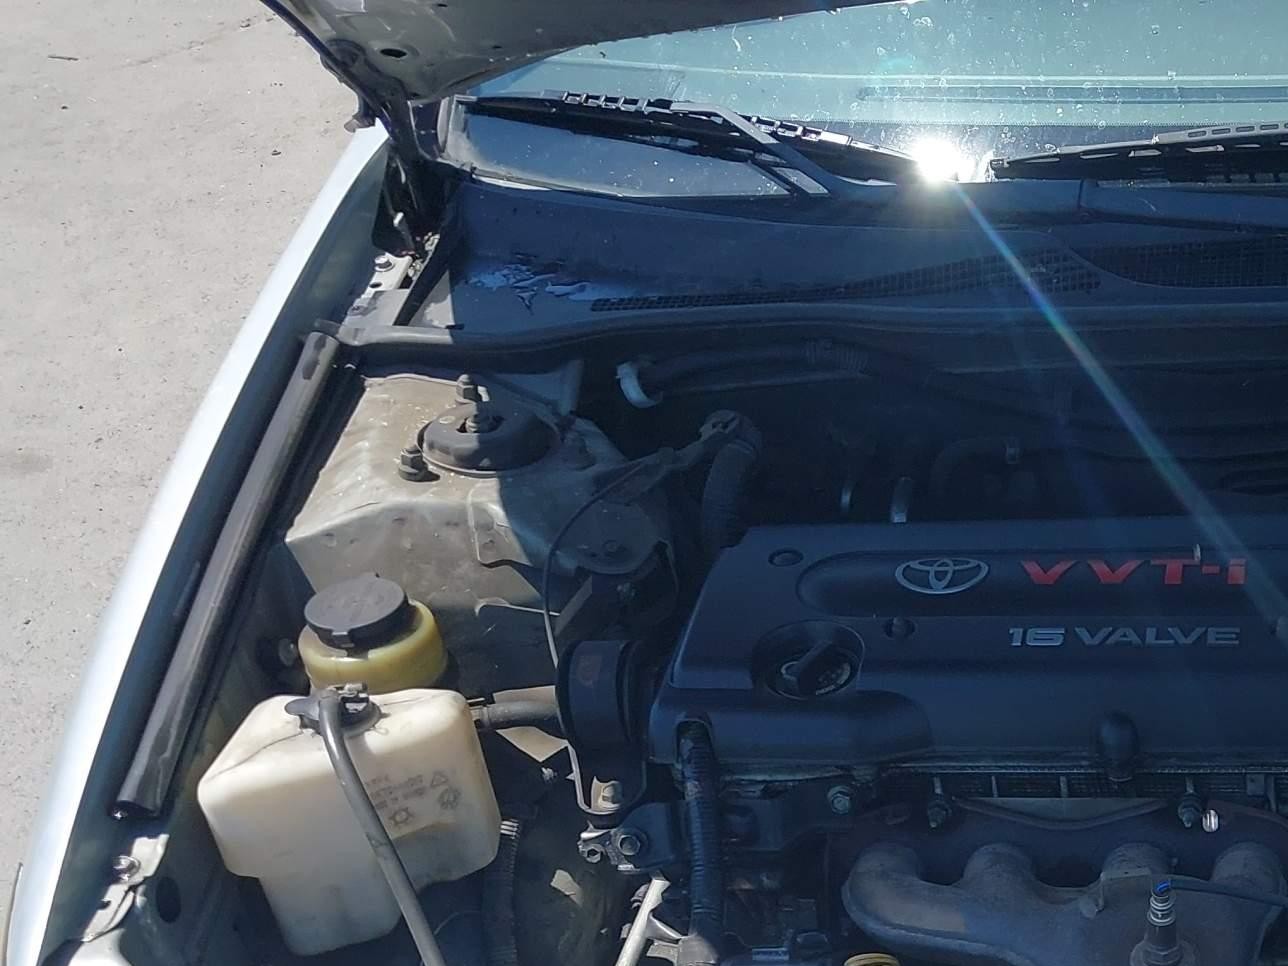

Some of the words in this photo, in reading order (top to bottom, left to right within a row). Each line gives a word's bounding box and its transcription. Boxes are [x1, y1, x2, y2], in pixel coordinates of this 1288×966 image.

[1020, 558, 1247, 585] VVT-i
[1008, 627, 1065, 646] 16
[1074, 627, 1241, 646] VALVE
